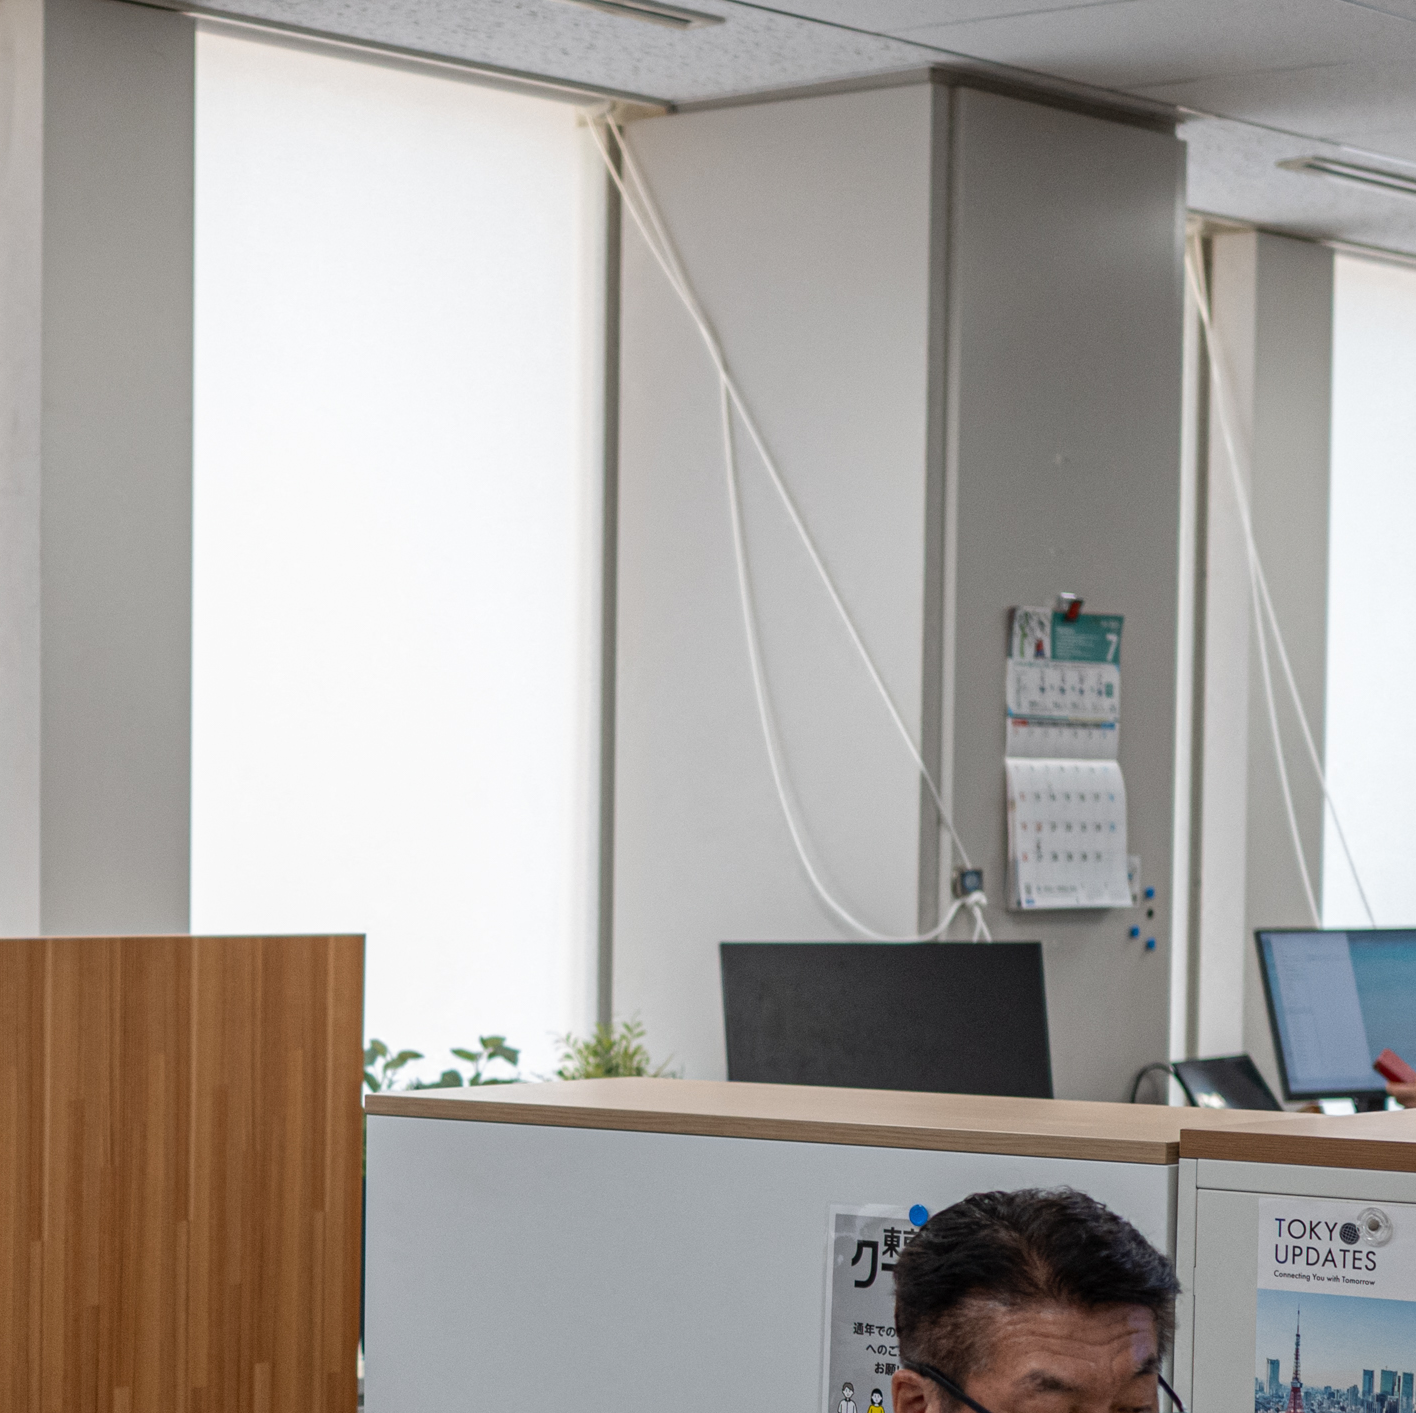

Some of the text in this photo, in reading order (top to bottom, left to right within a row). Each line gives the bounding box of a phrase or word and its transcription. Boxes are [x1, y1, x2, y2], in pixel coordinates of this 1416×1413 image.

[1106, 633, 1119, 662] 7
[1275, 1244, 1376, 1271] UPDATES
[1274, 1270, 1310, 1282] Connecting
[1326, 1275, 1340, 1283] with
[1342, 1276, 1375, 1285] Tomorrow
